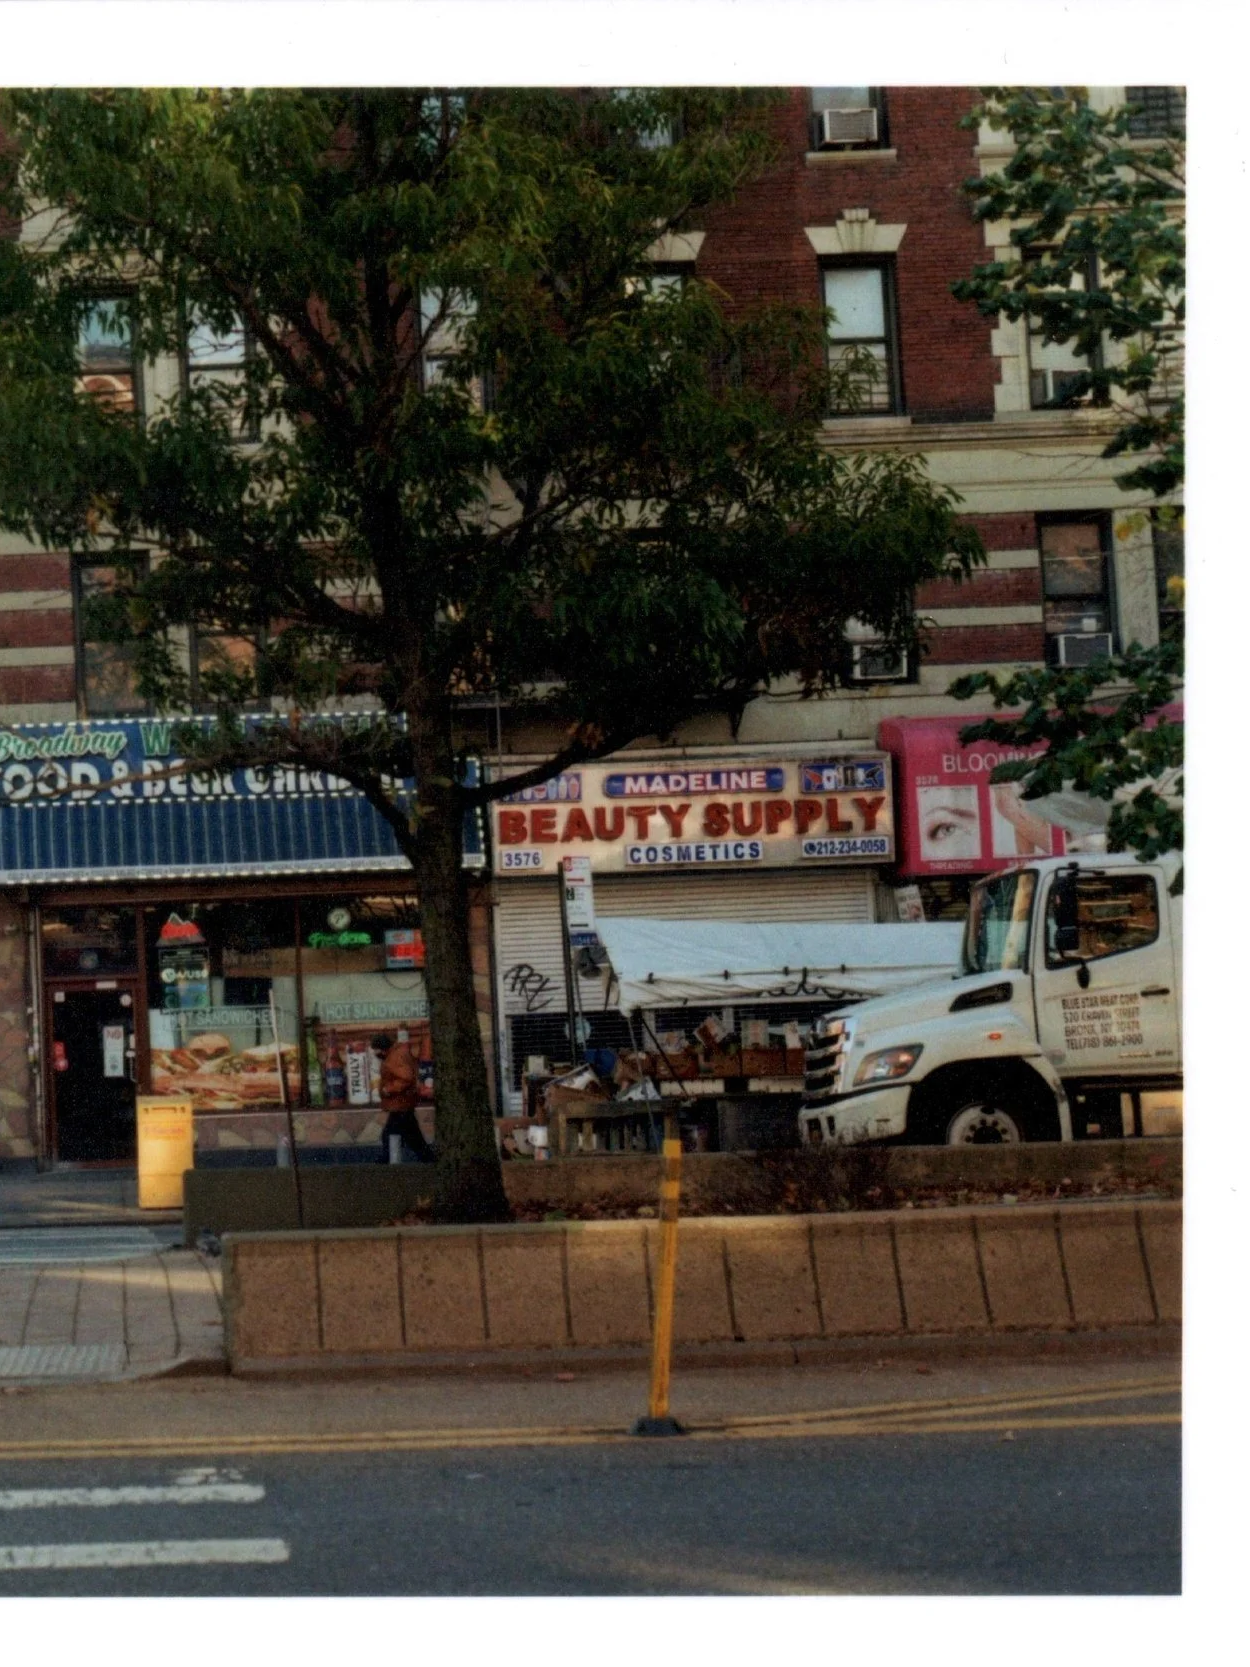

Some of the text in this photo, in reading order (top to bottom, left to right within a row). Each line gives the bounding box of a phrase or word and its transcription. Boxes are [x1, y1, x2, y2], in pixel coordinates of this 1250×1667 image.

[110, 760, 132, 797] &
[625, 771, 767, 794] MADELINE
[498, 797, 886, 844] BEAUTY SUPPLY
[630, 843, 760, 863] COSMETICS
[817, 840, 886, 855] 212-234-0058
[505, 853, 540, 866] 3576
[195, 1008, 271, 1026] SANDWICHE
[327, 1000, 427, 1018] HOT SANDWICHE
[350, 1056, 360, 1096] TRULY
